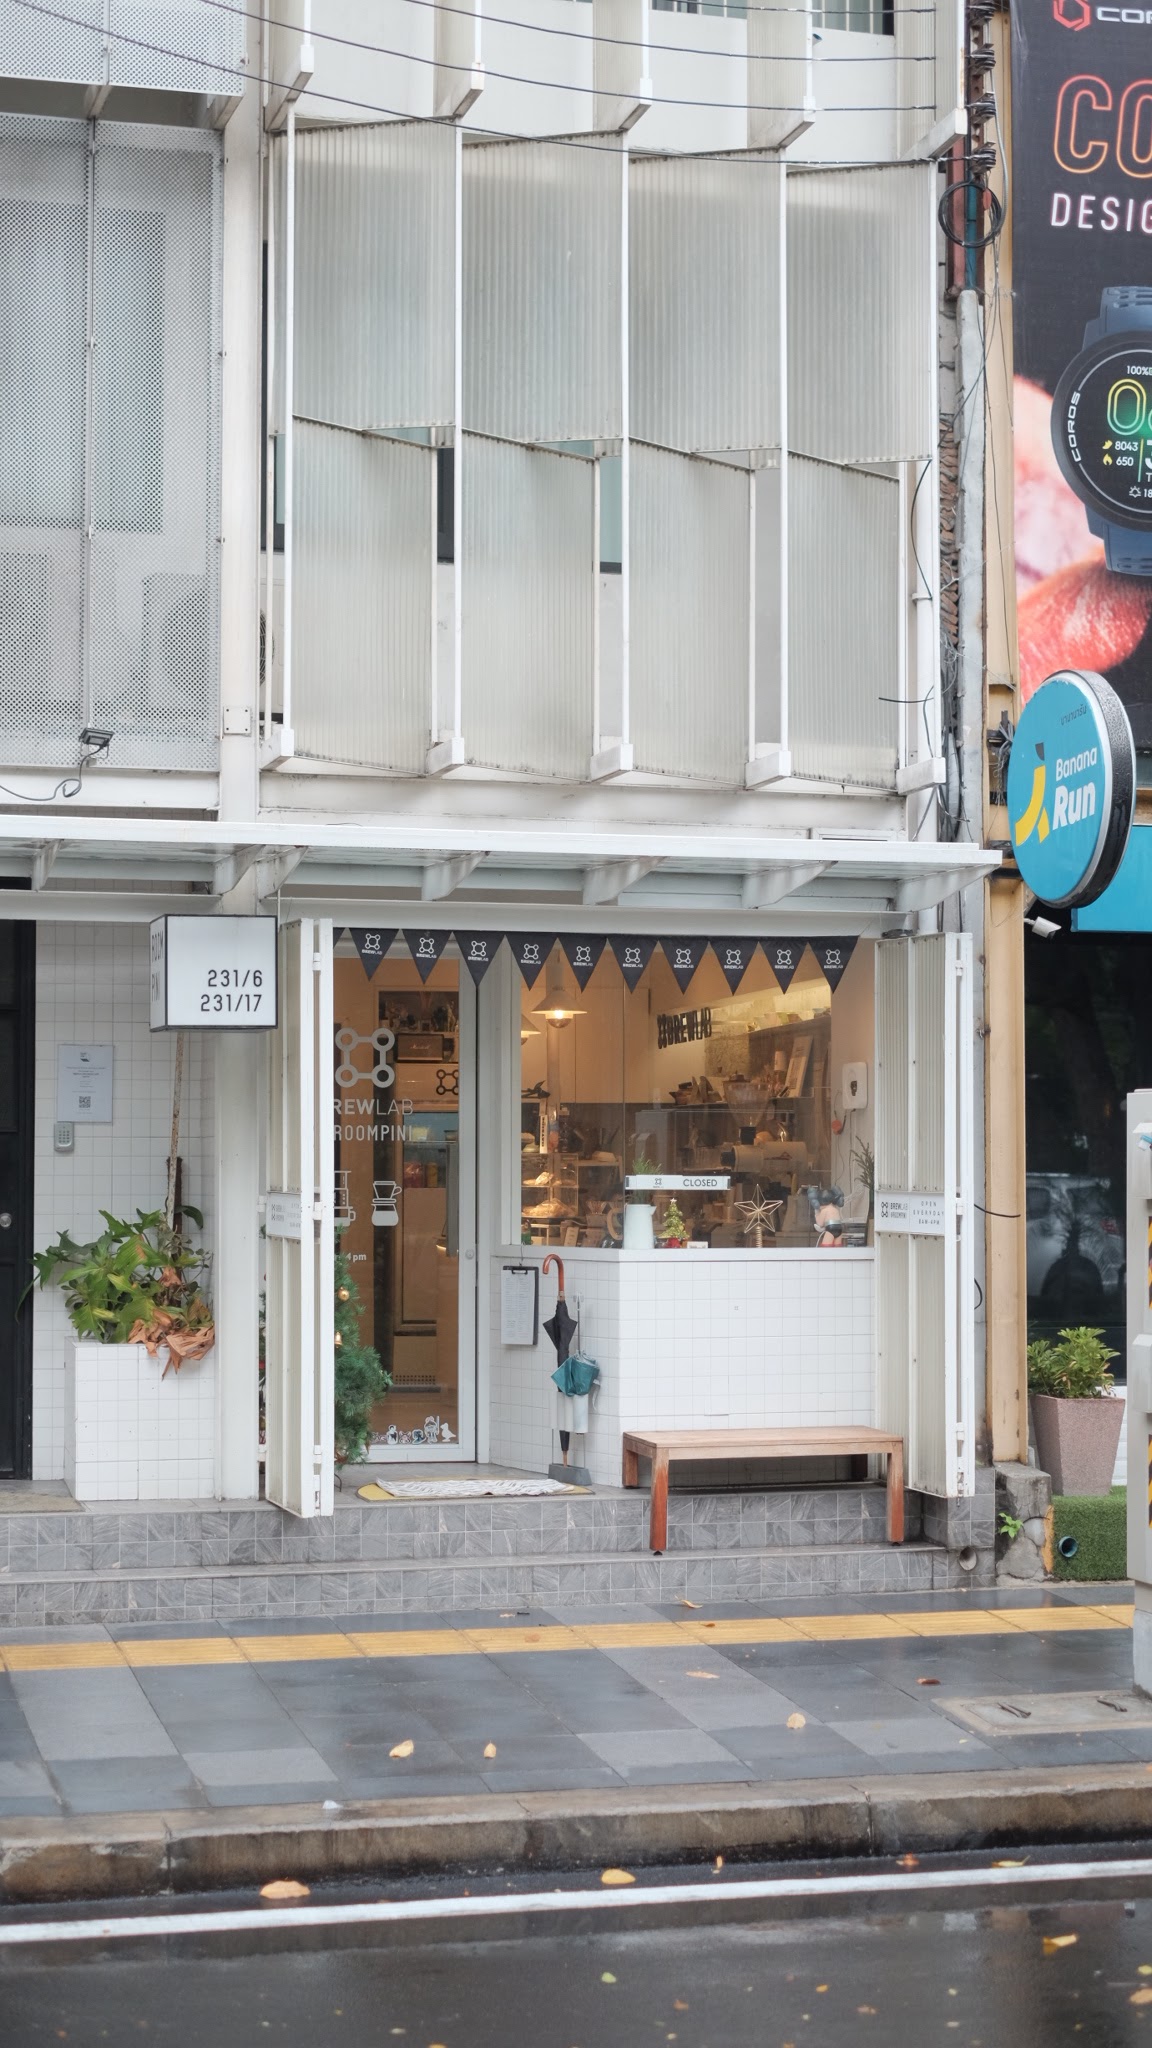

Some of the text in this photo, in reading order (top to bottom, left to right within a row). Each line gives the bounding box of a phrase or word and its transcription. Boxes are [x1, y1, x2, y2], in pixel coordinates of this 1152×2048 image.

[1096, 7, 1152, 24] CO
[1051, 193, 1152, 234] DESIG
[1127, 365, 1149, 376] 100%
[1067, 391, 1081, 463] COROS
[1114, 441, 1139, 451] 8043
[1116, 456, 1134, 467] 650
[1056, 747, 1097, 782] Banana
[1052, 782, 1096, 831] Run
[207, 969, 263, 988] 231/6
[200, 993, 263, 1013] 231/17
[667, 1006, 712, 1046] BREWLAB
[683, 1178, 718, 1187] CLOSED
